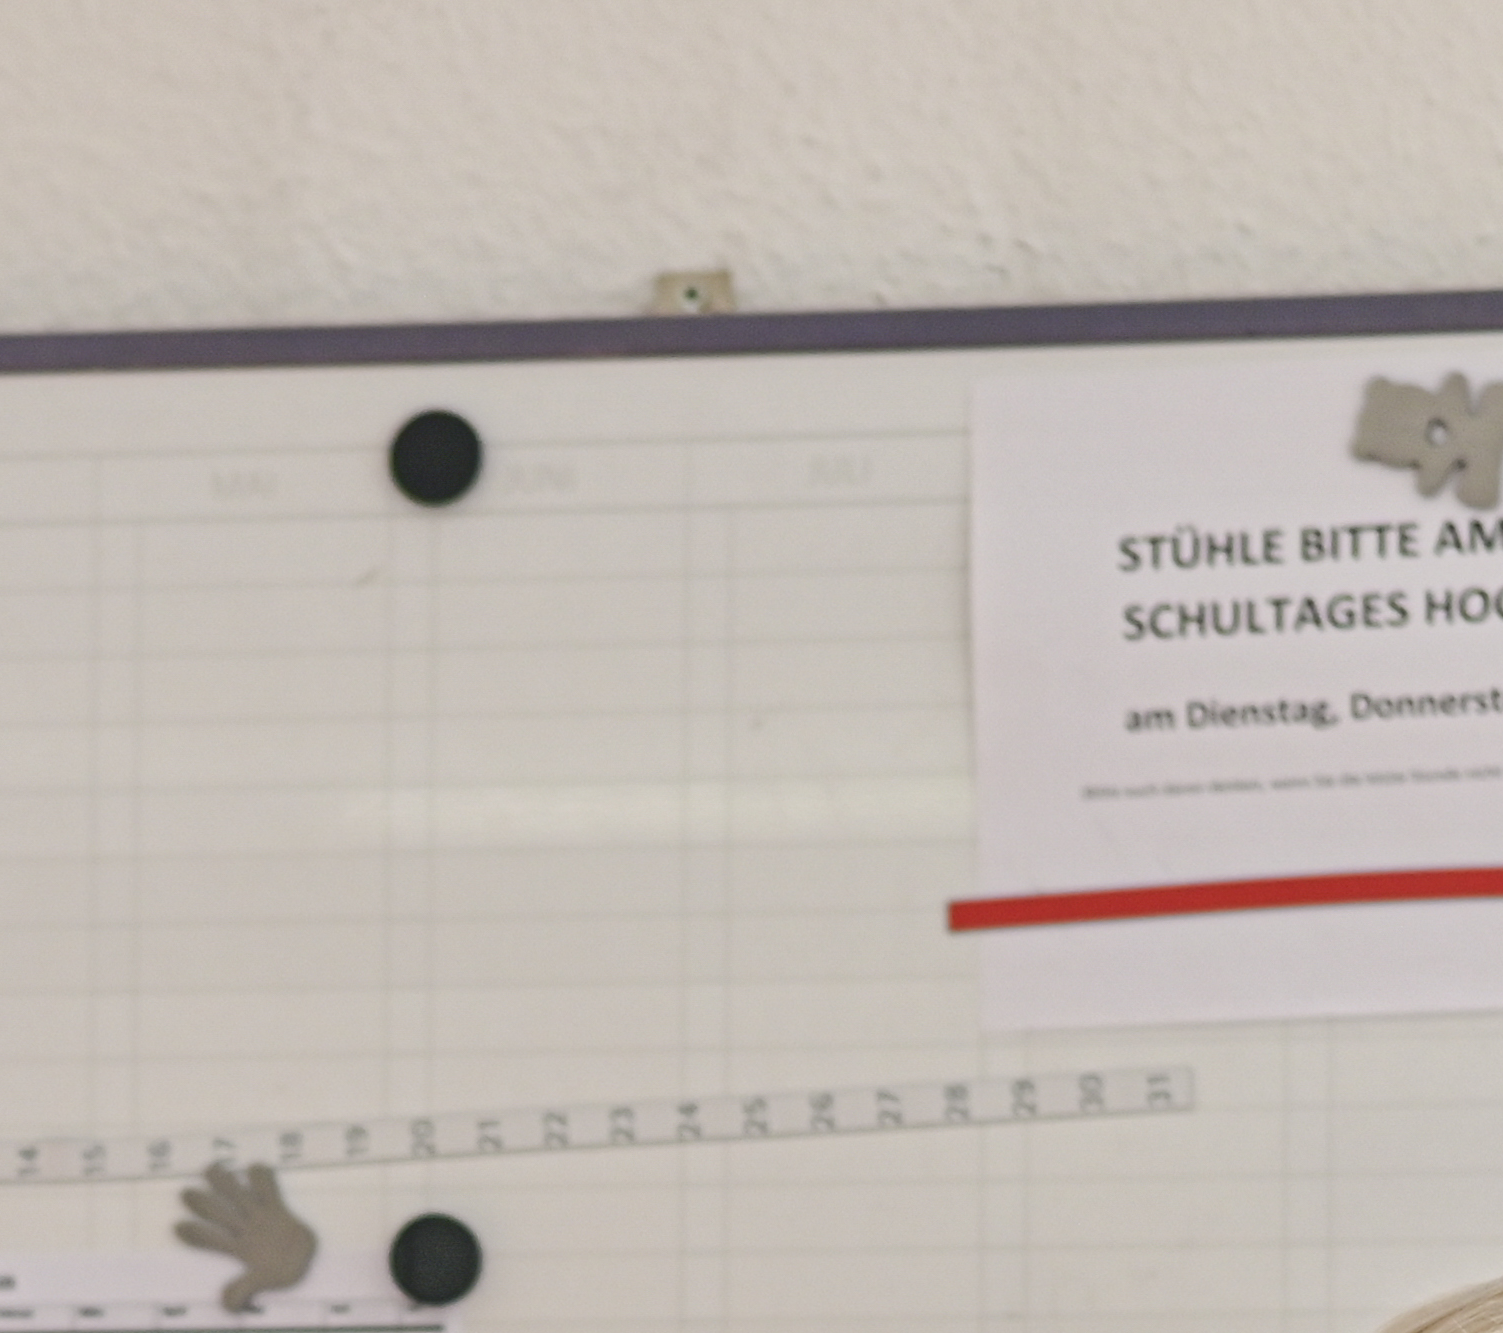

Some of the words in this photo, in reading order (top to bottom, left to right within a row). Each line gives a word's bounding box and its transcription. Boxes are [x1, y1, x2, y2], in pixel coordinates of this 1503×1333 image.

[1118, 524, 1285, 572] STÜHLE
[1300, 520, 1420, 562] BITTE
[1122, 590, 1408, 641] SCHULTAGES
[1124, 709, 1176, 732] am
[1186, 696, 1338, 729] Dienstag,
